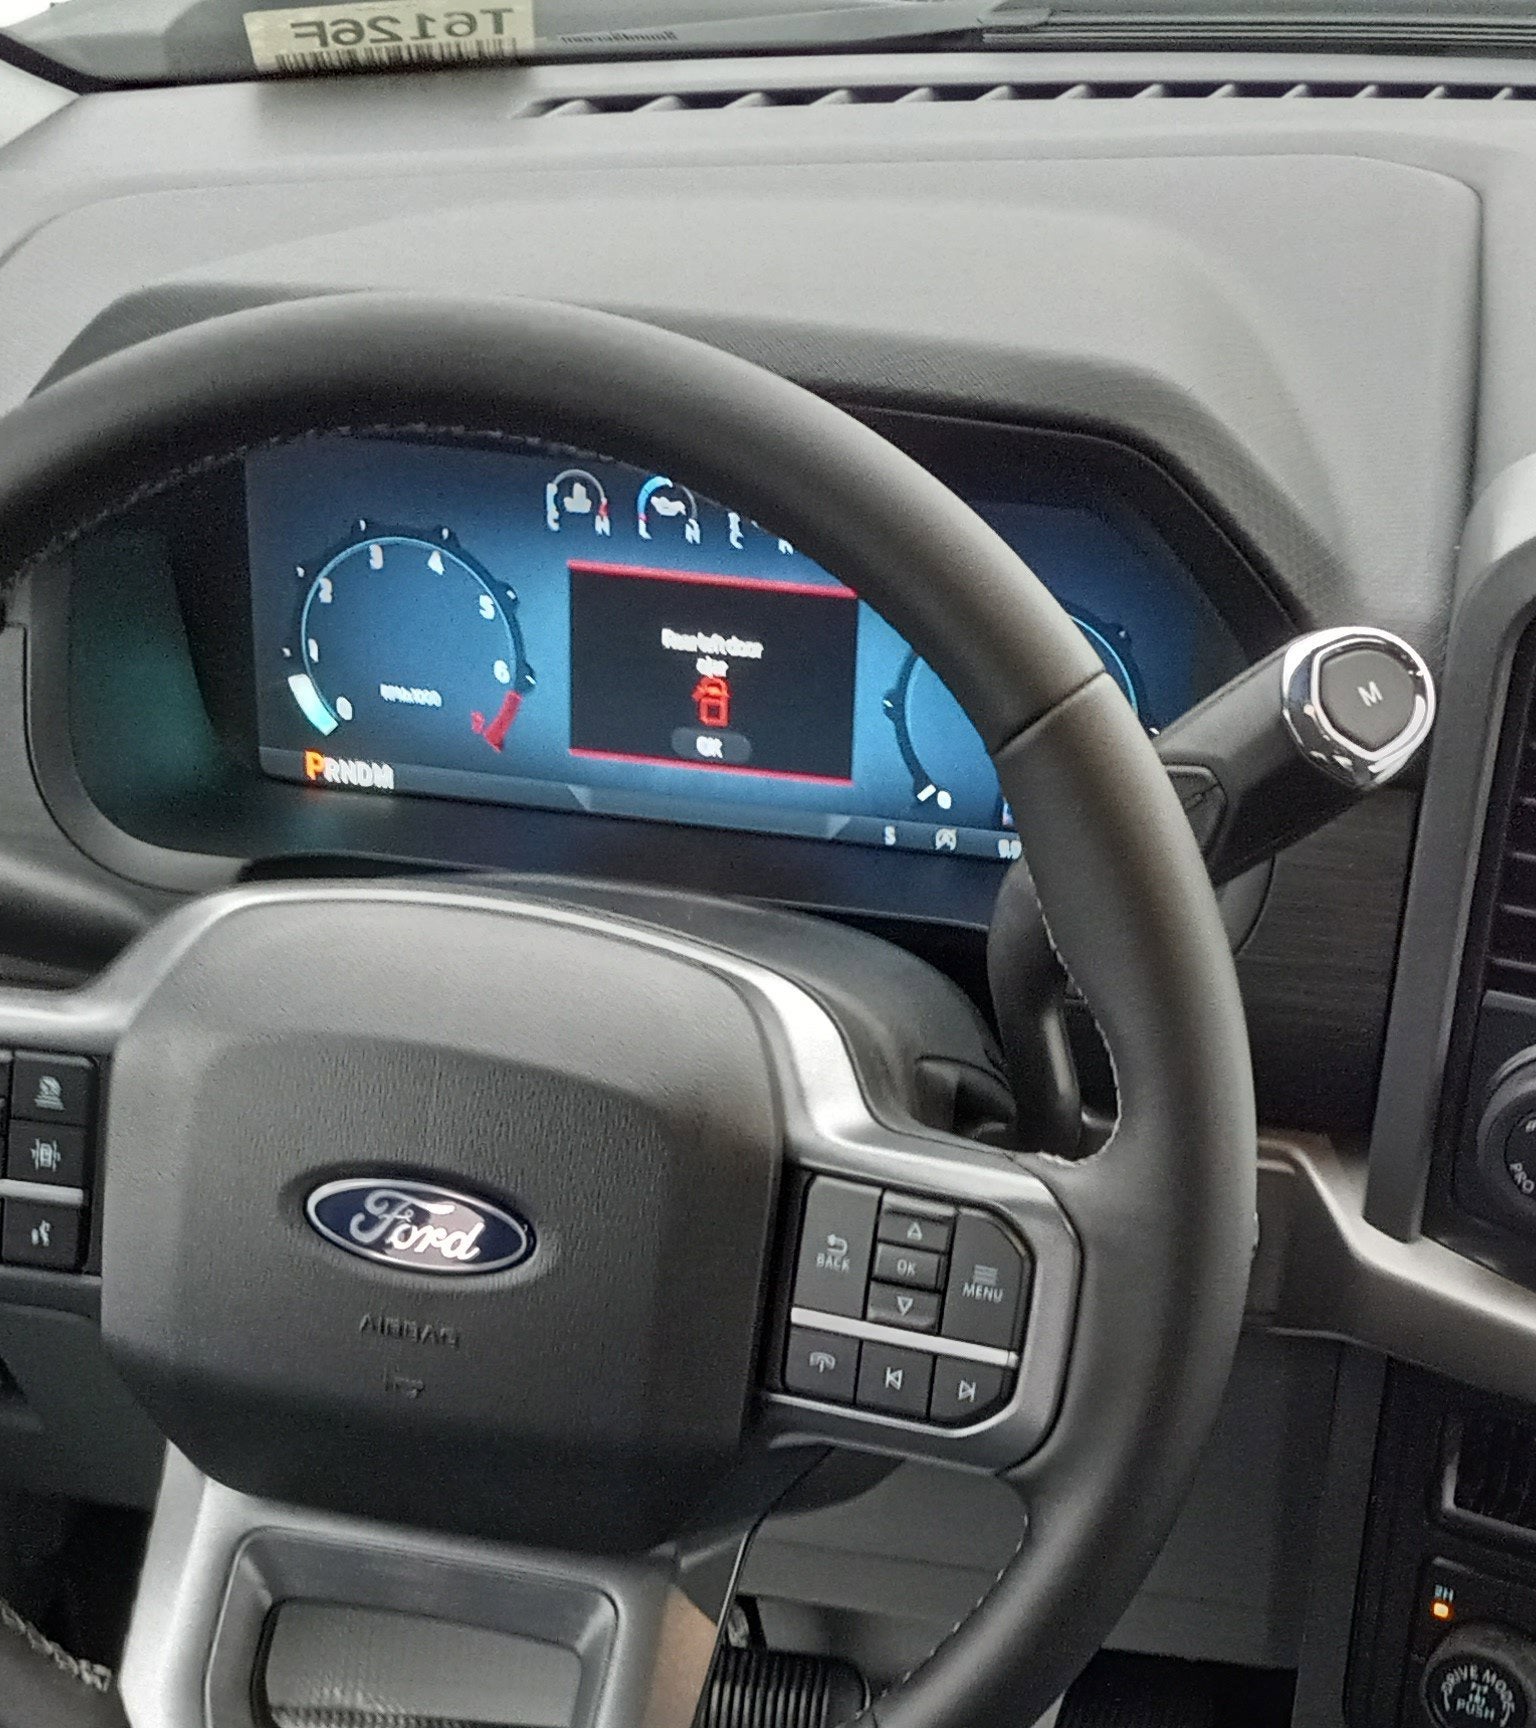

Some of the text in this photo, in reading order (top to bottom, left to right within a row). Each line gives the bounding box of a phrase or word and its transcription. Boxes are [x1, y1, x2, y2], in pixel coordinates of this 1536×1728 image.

[478, 593, 496, 620] 5
[492, 659, 511, 684] 6
[695, 735, 724, 759] OK
[1509, 1161, 1535, 1195] PRO
[349, 1188, 486, 1262] Ford
[815, 1253, 851, 1274] BACK
[896, 1258, 916, 1278] OK
[962, 1281, 1005, 1304] MENU
[1440, 1664, 1515, 1713] DRIVE MODE
[1455, 1697, 1496, 1722] PUSH
